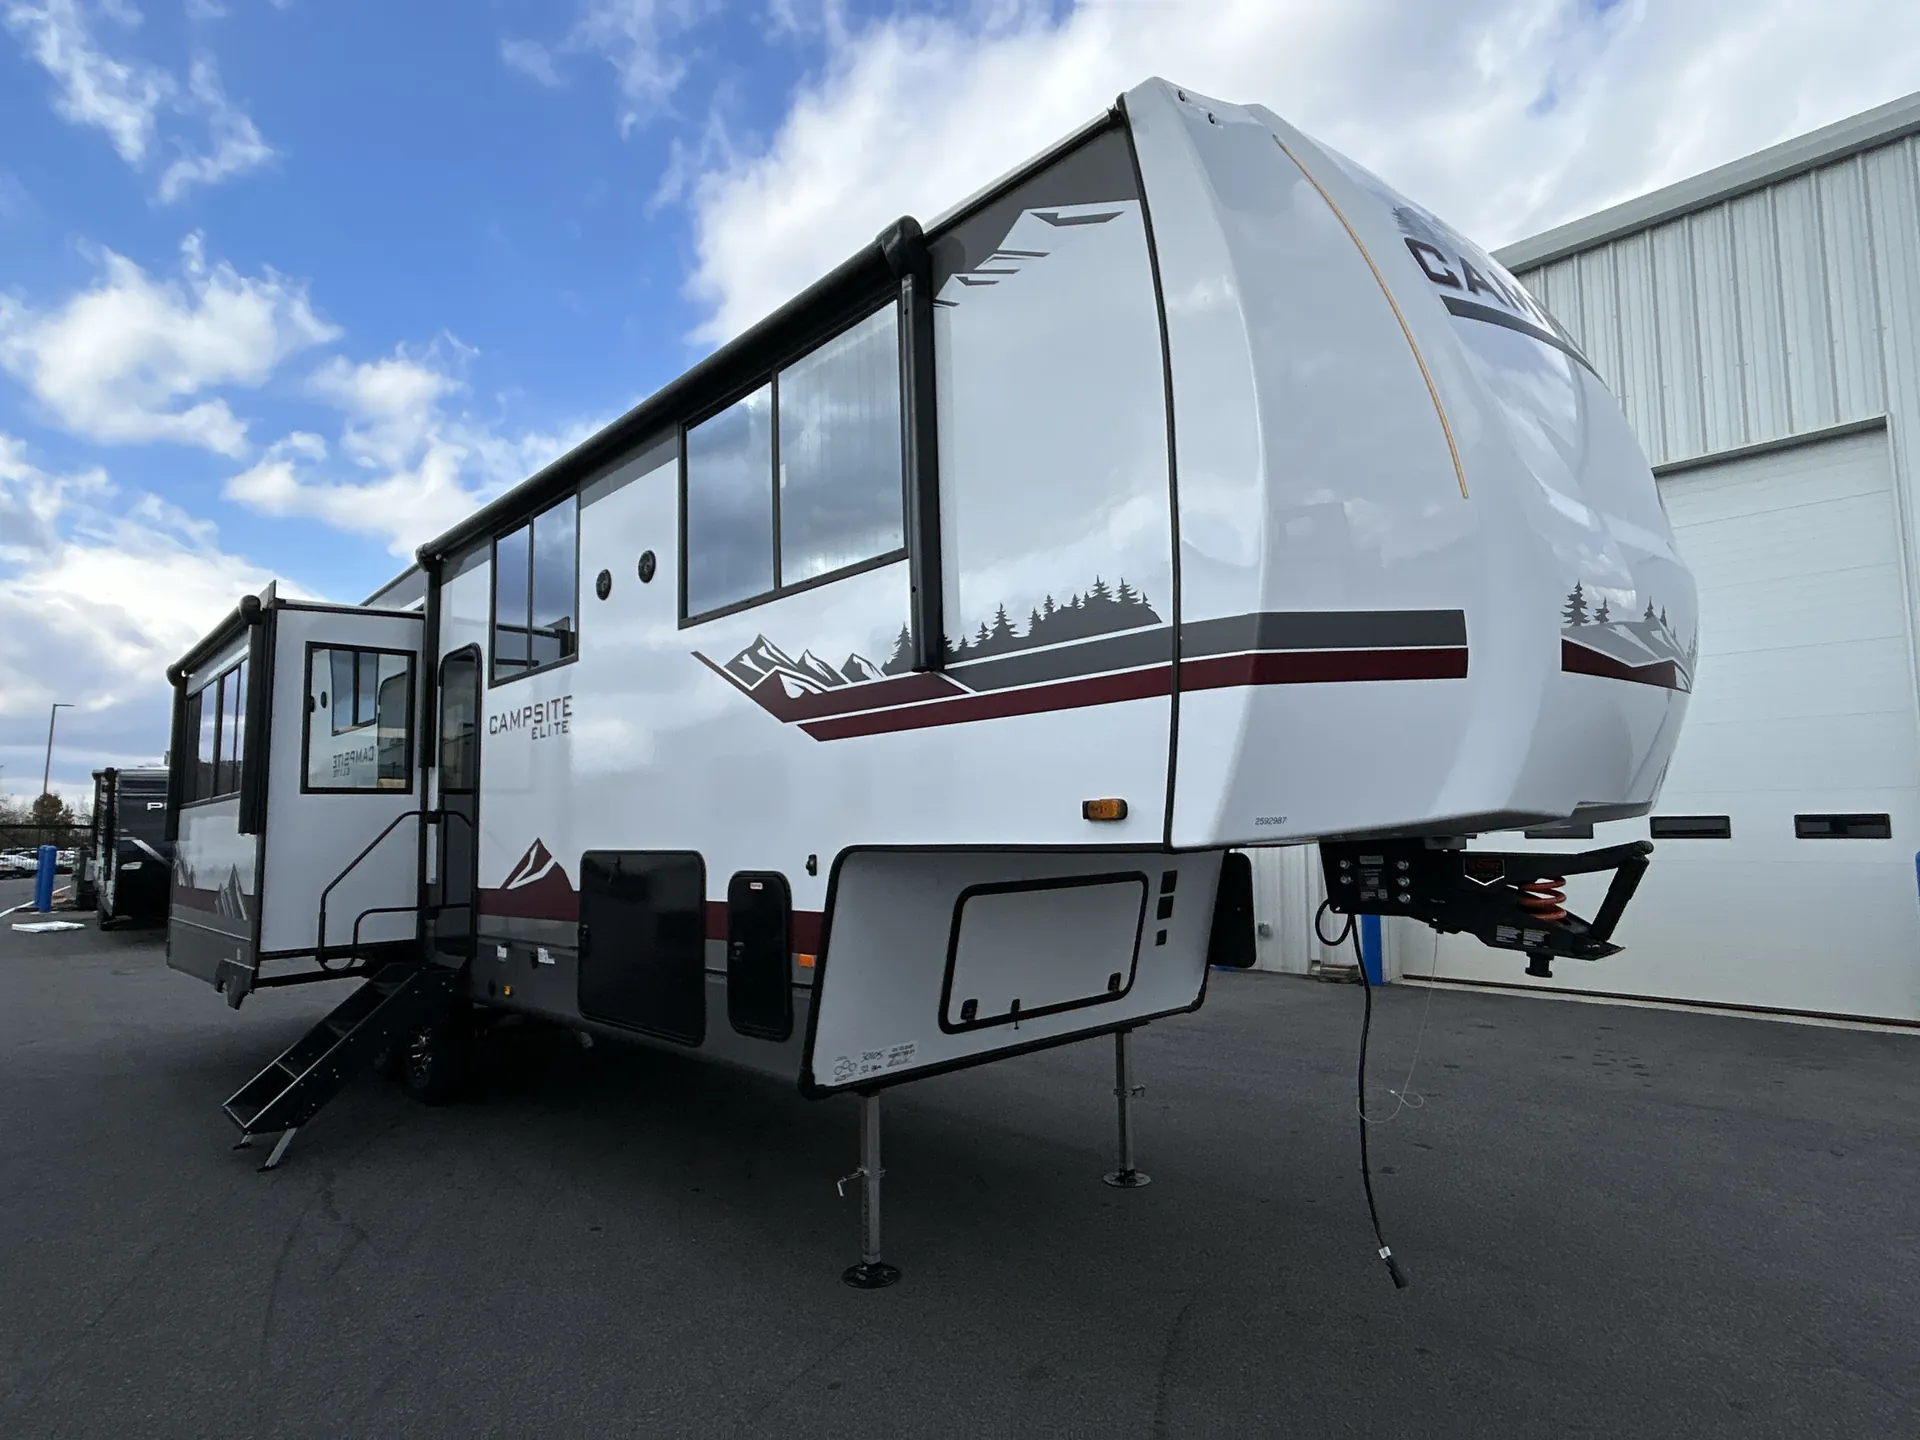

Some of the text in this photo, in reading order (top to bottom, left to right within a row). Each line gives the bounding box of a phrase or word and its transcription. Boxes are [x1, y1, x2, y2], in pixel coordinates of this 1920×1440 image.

[489, 695, 573, 735] CAMPSITE
[531, 720, 569, 740] ELITE
[1255, 816, 1288, 826] 2592987
